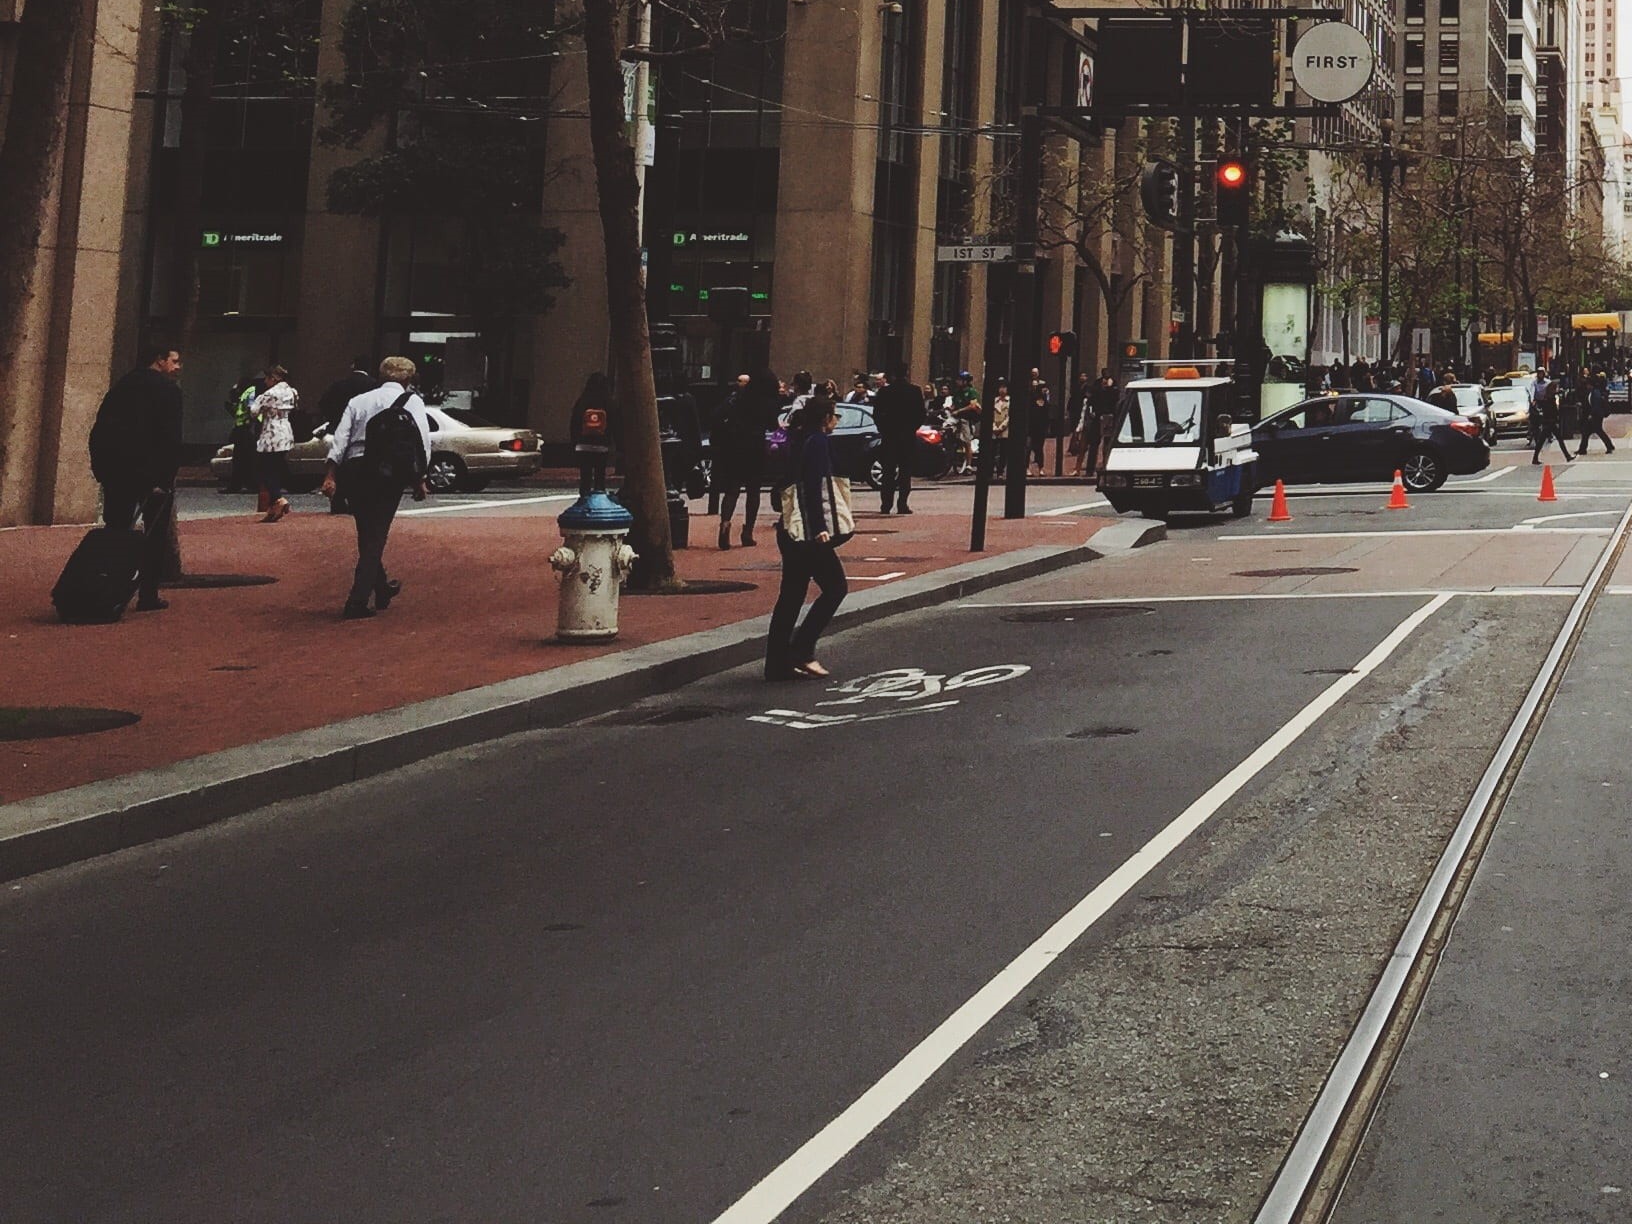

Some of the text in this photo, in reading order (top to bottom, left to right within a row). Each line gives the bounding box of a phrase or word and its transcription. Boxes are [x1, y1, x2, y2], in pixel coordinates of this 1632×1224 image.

[1306, 55, 1358, 69] FIRST
[203, 233, 220, 245] TD
[673, 233, 686, 245] D
[953, 248, 997, 259] 1ST ST
